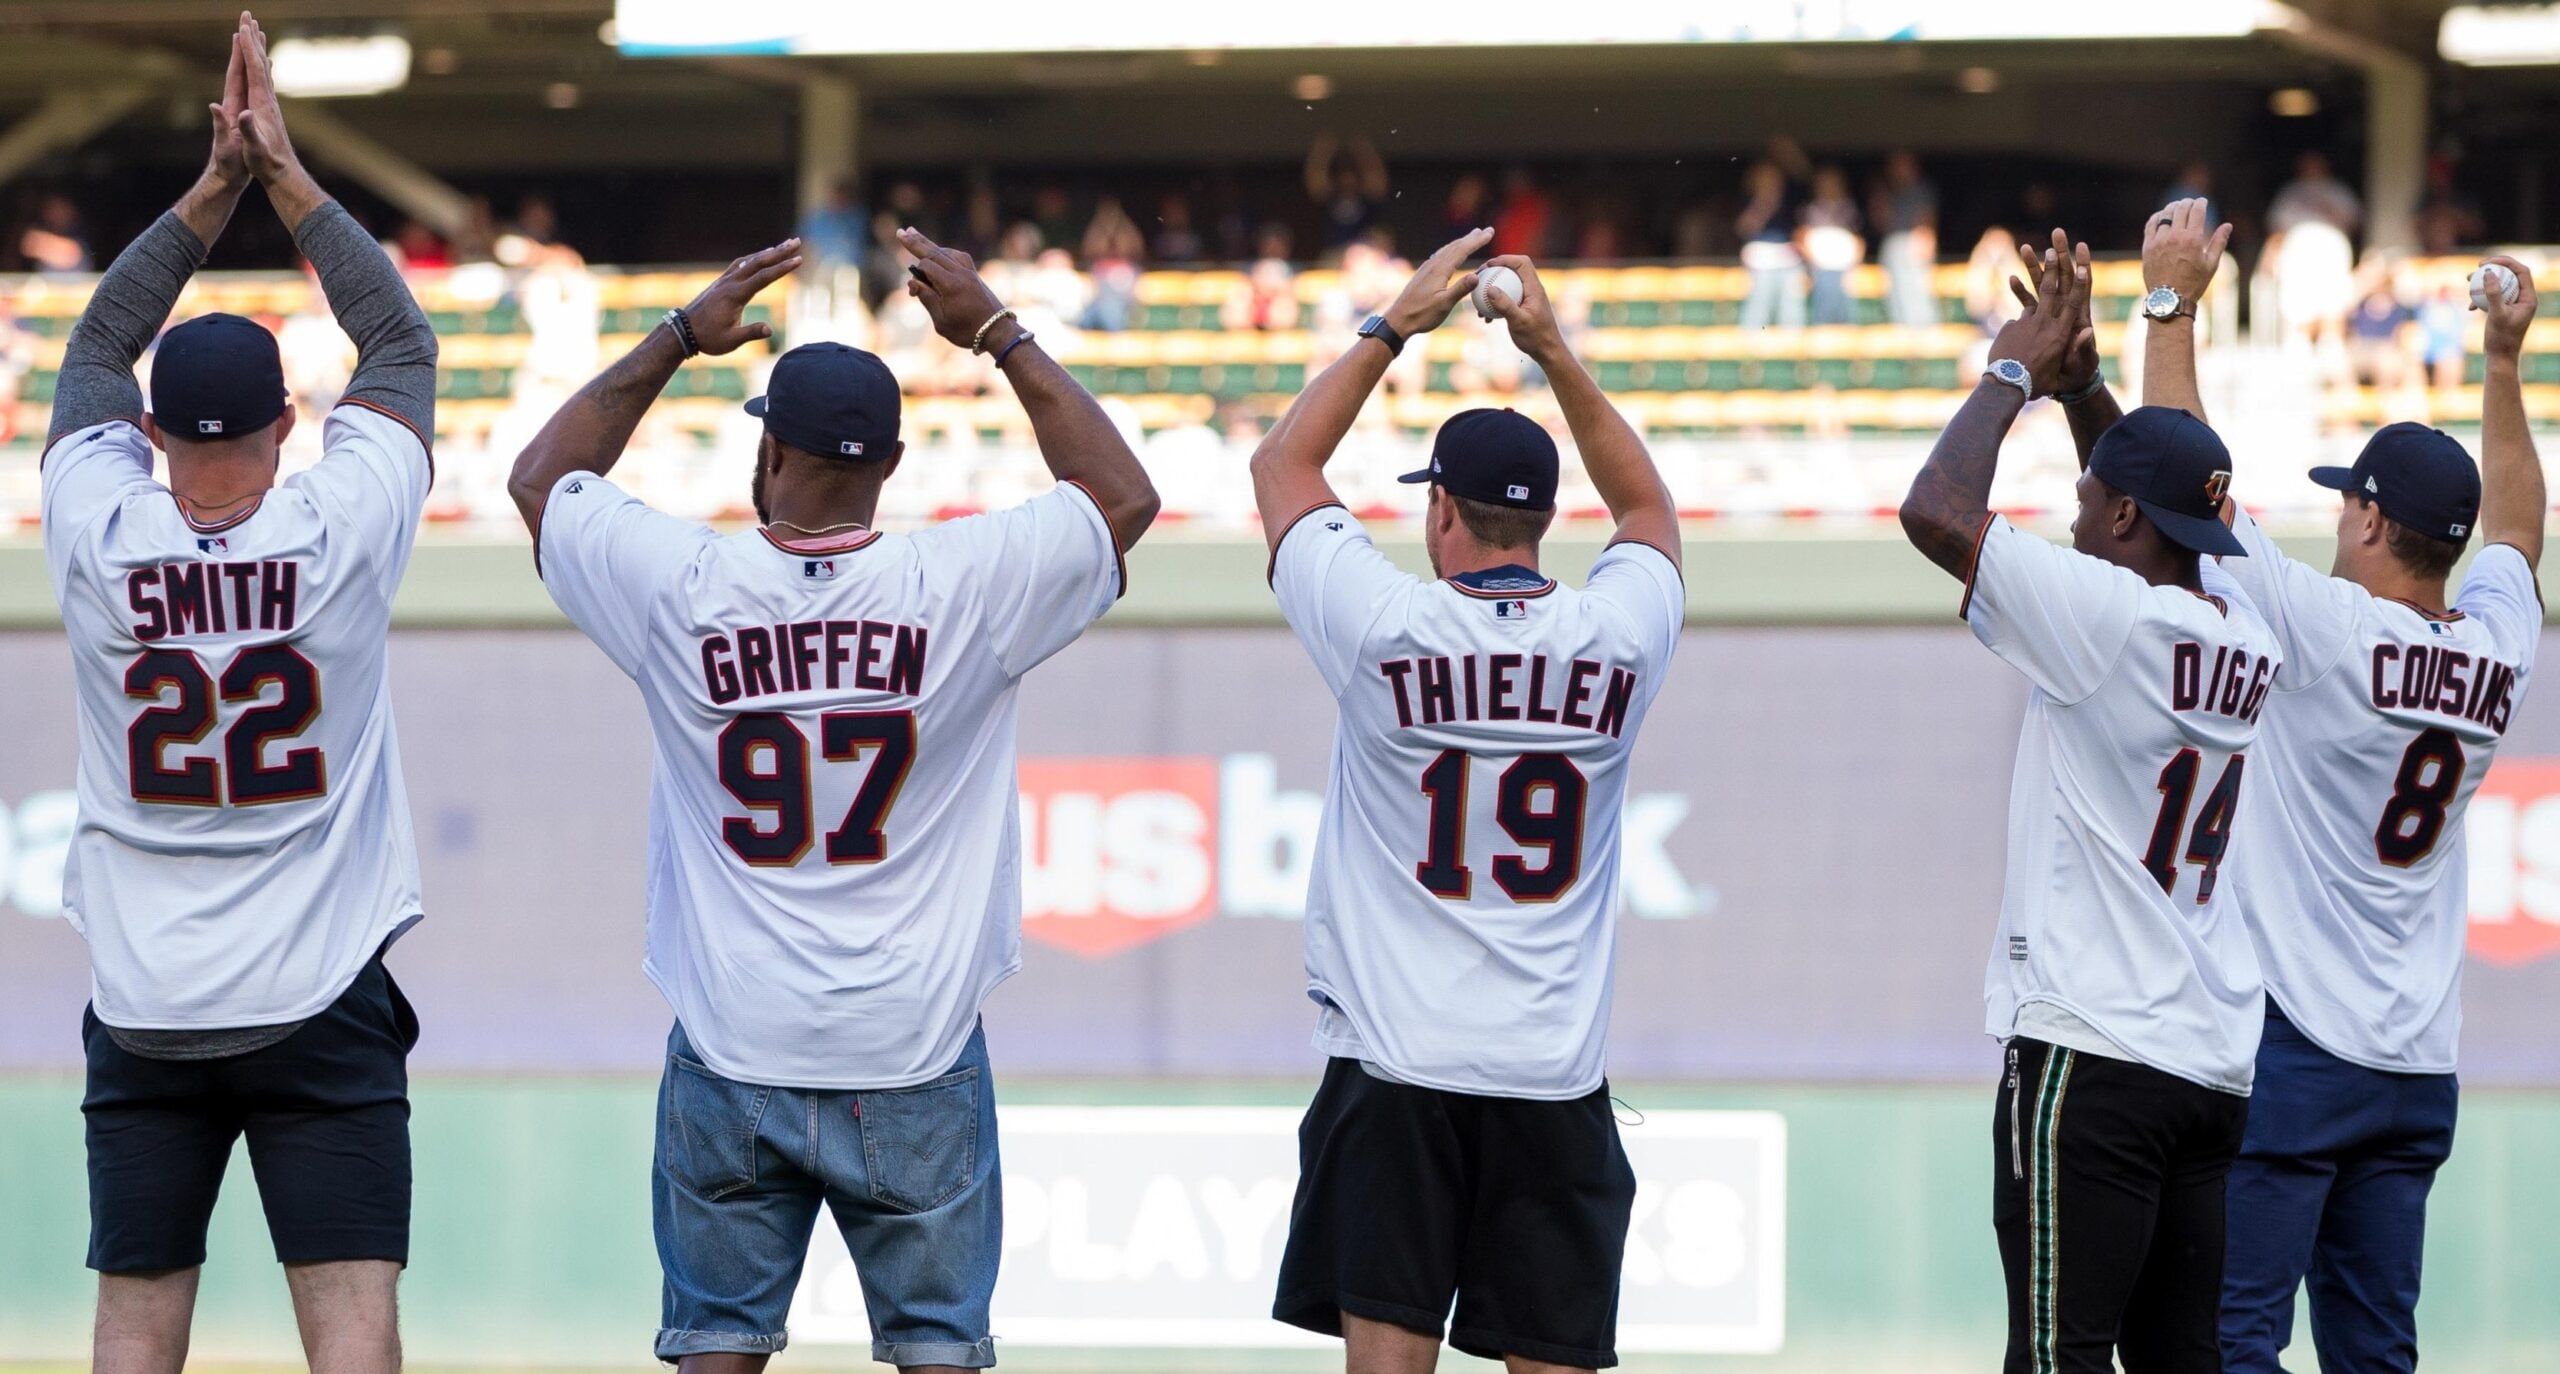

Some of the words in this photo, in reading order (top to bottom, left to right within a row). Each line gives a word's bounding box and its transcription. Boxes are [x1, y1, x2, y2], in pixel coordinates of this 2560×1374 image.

[128, 561, 297, 642] SMITH
[701, 620, 928, 705] GRIFFEN
[124, 643, 328, 808] 22
[1379, 653, 1637, 739] THIELEN
[2372, 643, 2515, 737] COUSINS
[717, 709, 919, 868] 97
[1416, 747, 1589, 904] 19
[2139, 746, 2246, 905] 14
[2374, 727, 2467, 870] 8
